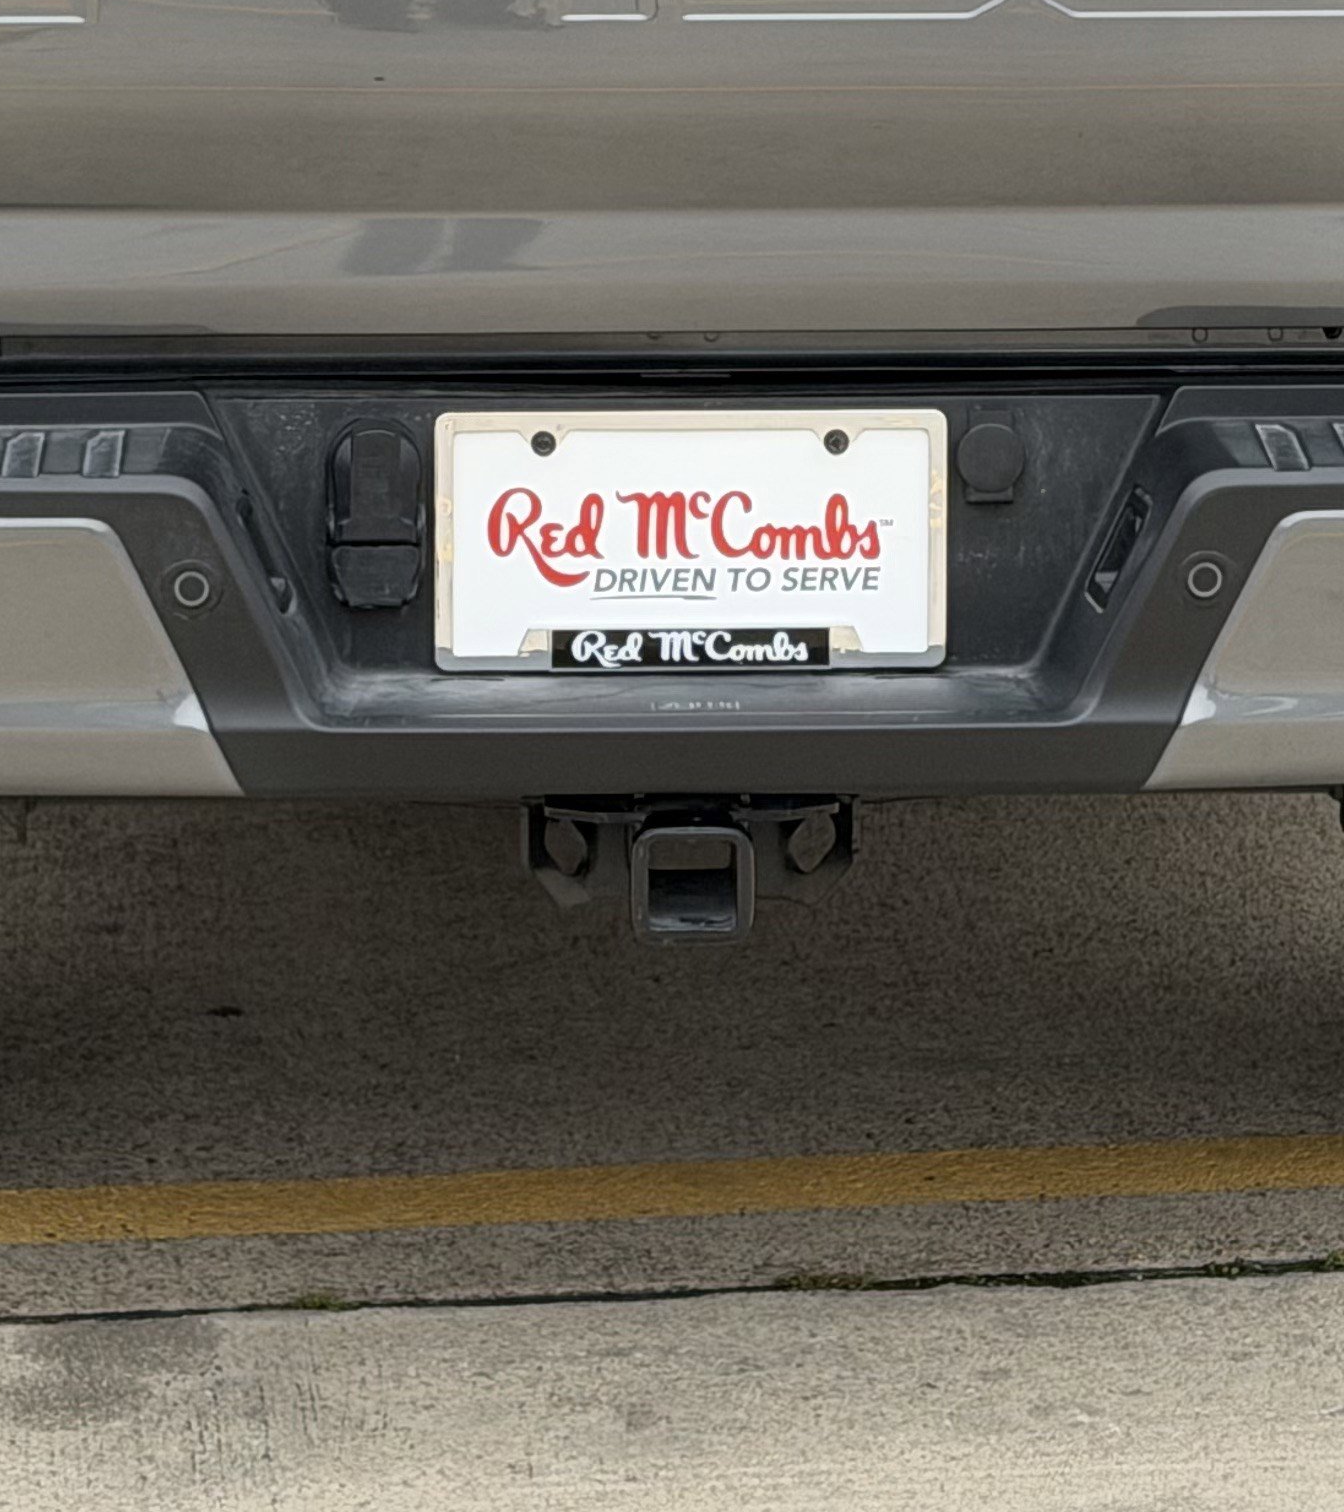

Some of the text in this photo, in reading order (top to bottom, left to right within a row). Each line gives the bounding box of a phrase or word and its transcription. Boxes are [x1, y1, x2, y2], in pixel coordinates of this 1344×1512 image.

[487, 487, 605, 588] Red
[615, 490, 881, 561] McCombs
[593, 566, 881, 593] DRIVEN TO SERVE
[571, 630, 809, 668] Red McCombs
